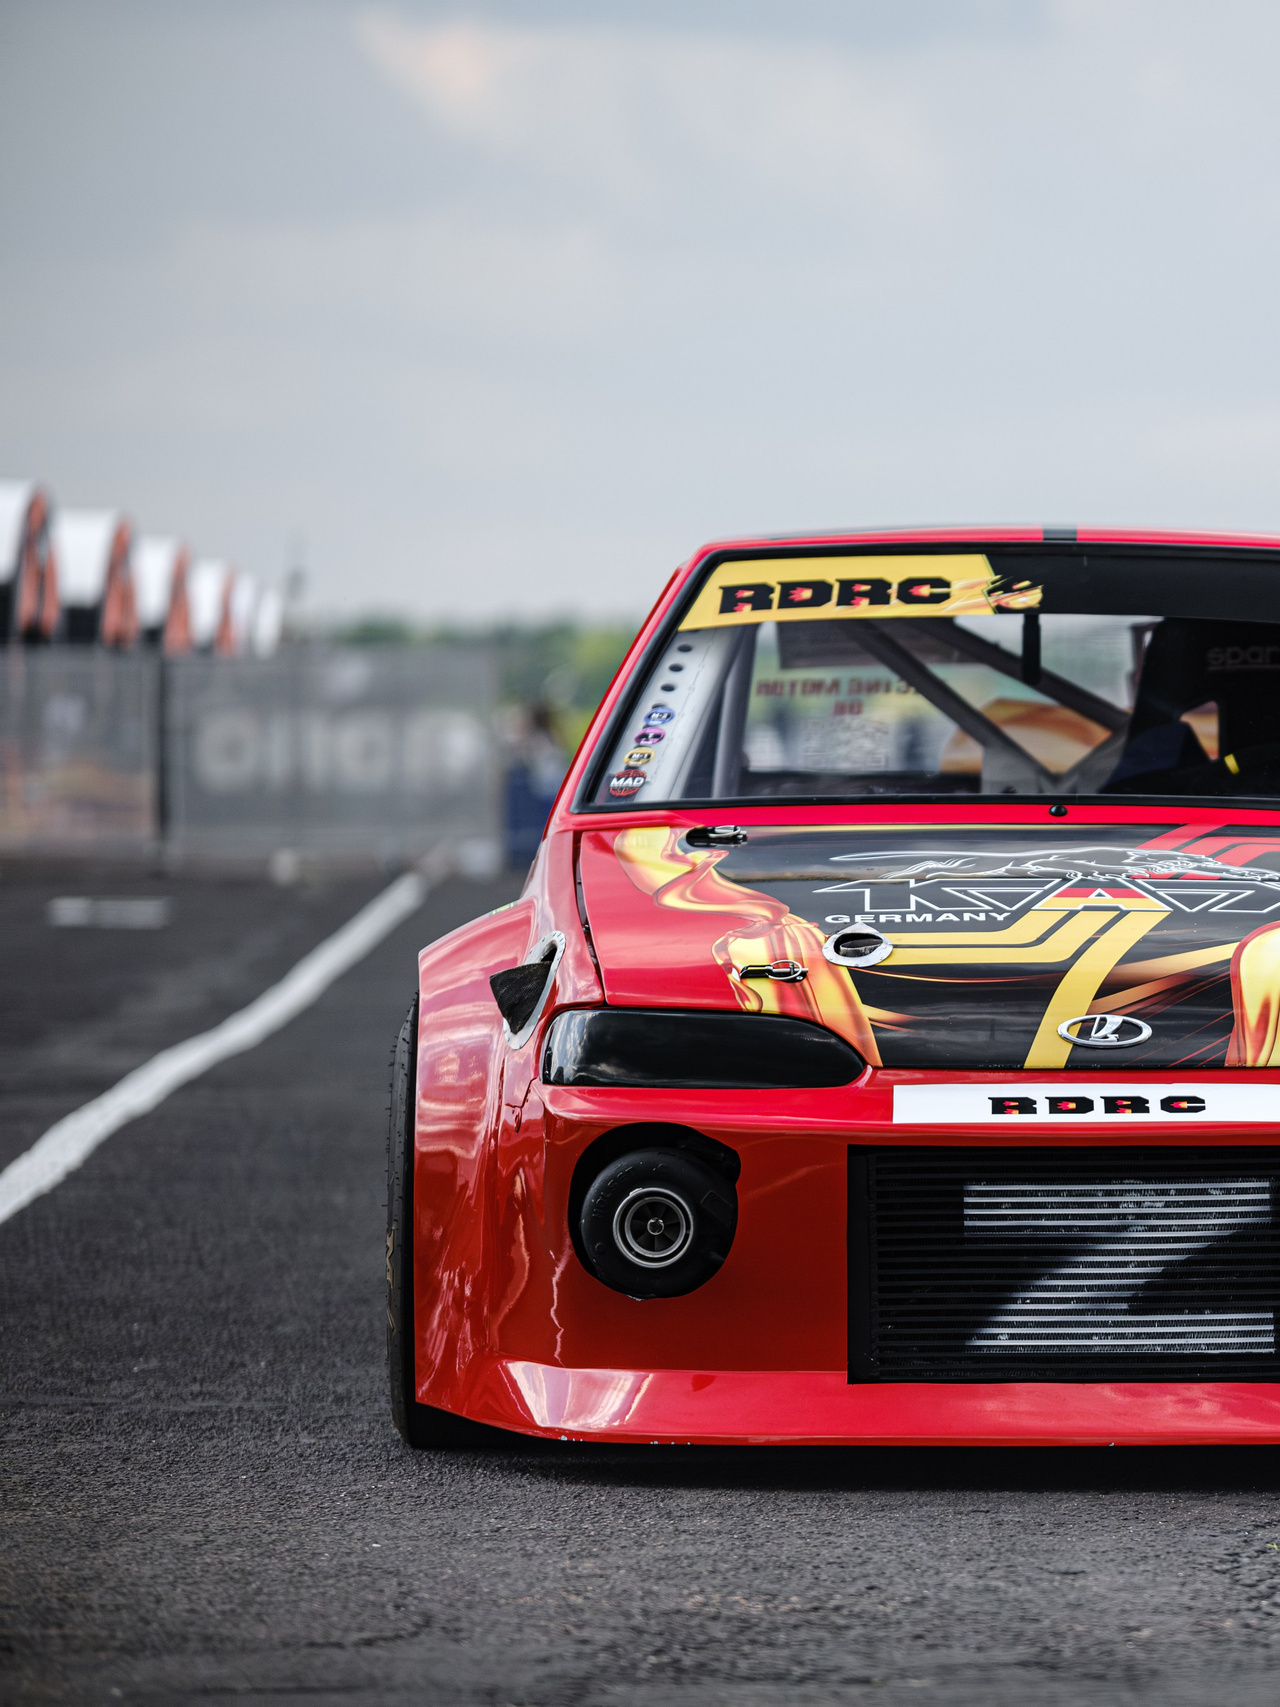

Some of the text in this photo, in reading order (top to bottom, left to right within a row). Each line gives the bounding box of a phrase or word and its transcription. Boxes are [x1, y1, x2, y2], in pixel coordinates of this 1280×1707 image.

[718, 576, 952, 615] RDRC
[610, 776, 645, 788] MAD
[824, 912, 1012, 924] GERMANY
[988, 1095, 1206, 1115] RDRC
